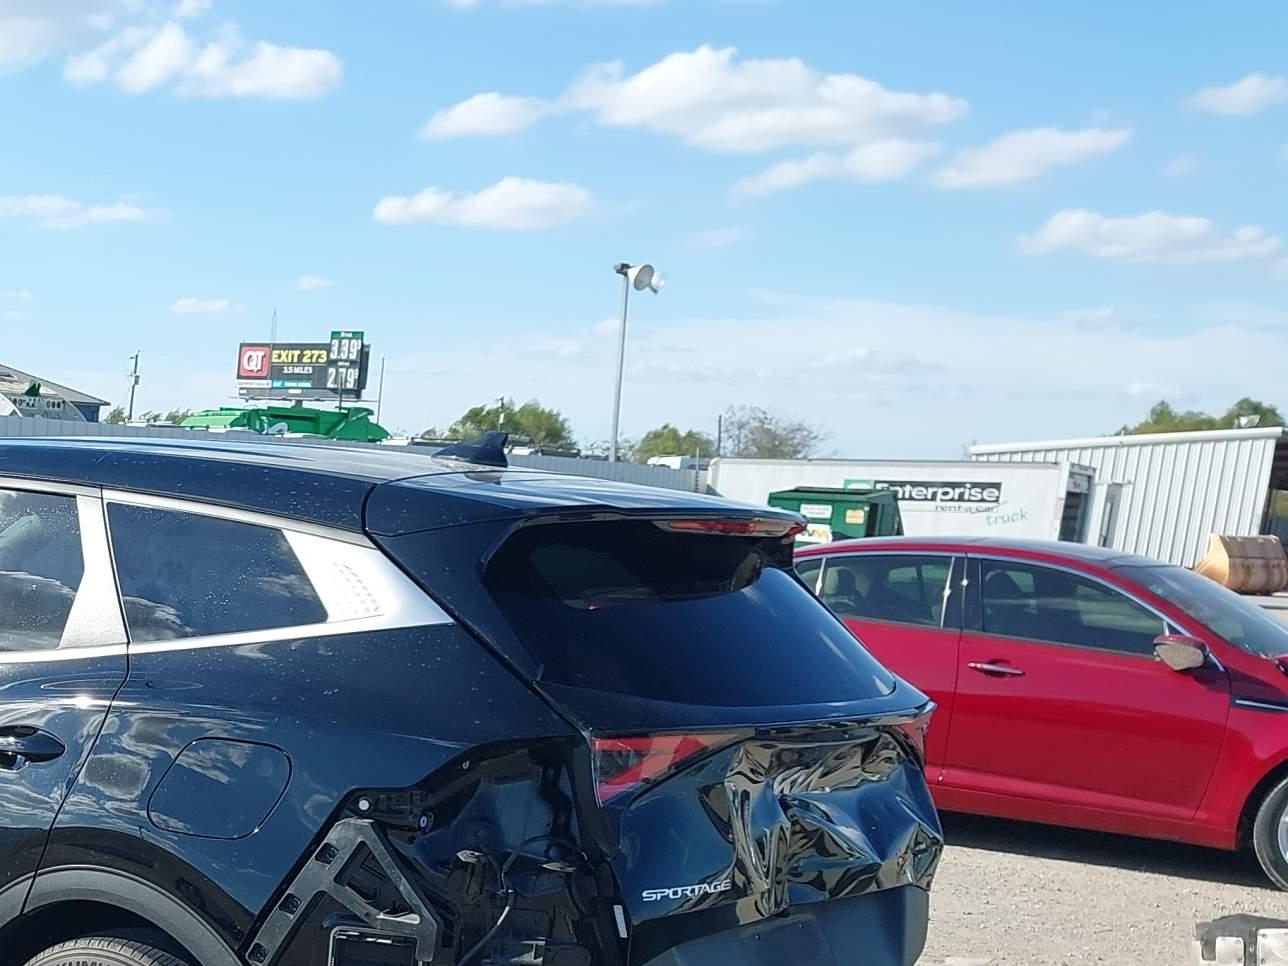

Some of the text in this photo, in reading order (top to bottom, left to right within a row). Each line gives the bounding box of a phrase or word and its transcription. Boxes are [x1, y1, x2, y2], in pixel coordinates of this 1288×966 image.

[242, 350, 267, 373] QT
[272, 350, 328, 363] EXIT 273
[294, 366, 313, 374] MILES
[986, 508, 1029, 526] truck
[642, 879, 731, 902] SPORTAGE
